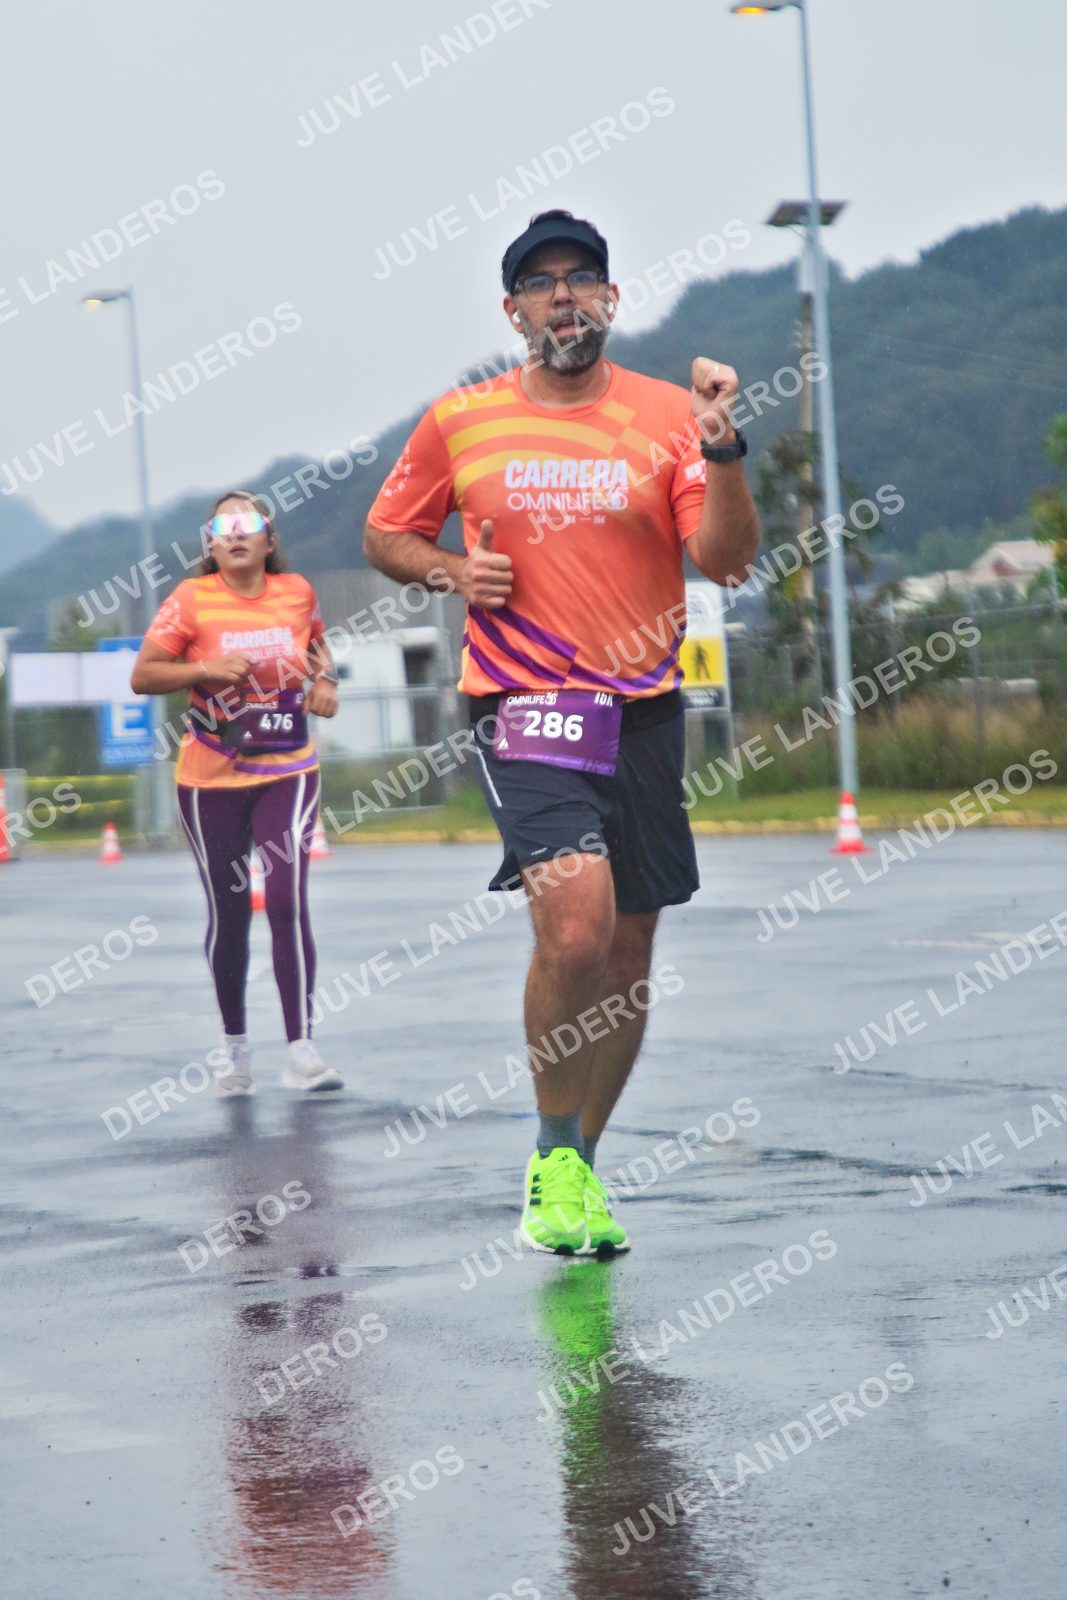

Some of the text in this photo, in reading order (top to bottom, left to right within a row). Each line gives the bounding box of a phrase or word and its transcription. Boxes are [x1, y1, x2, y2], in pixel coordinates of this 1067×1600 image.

[505, 459, 629, 489] CARRERA
[111, 702, 147, 737] E
[260, 713, 294, 730] 476
[523, 710, 584, 741] 286
